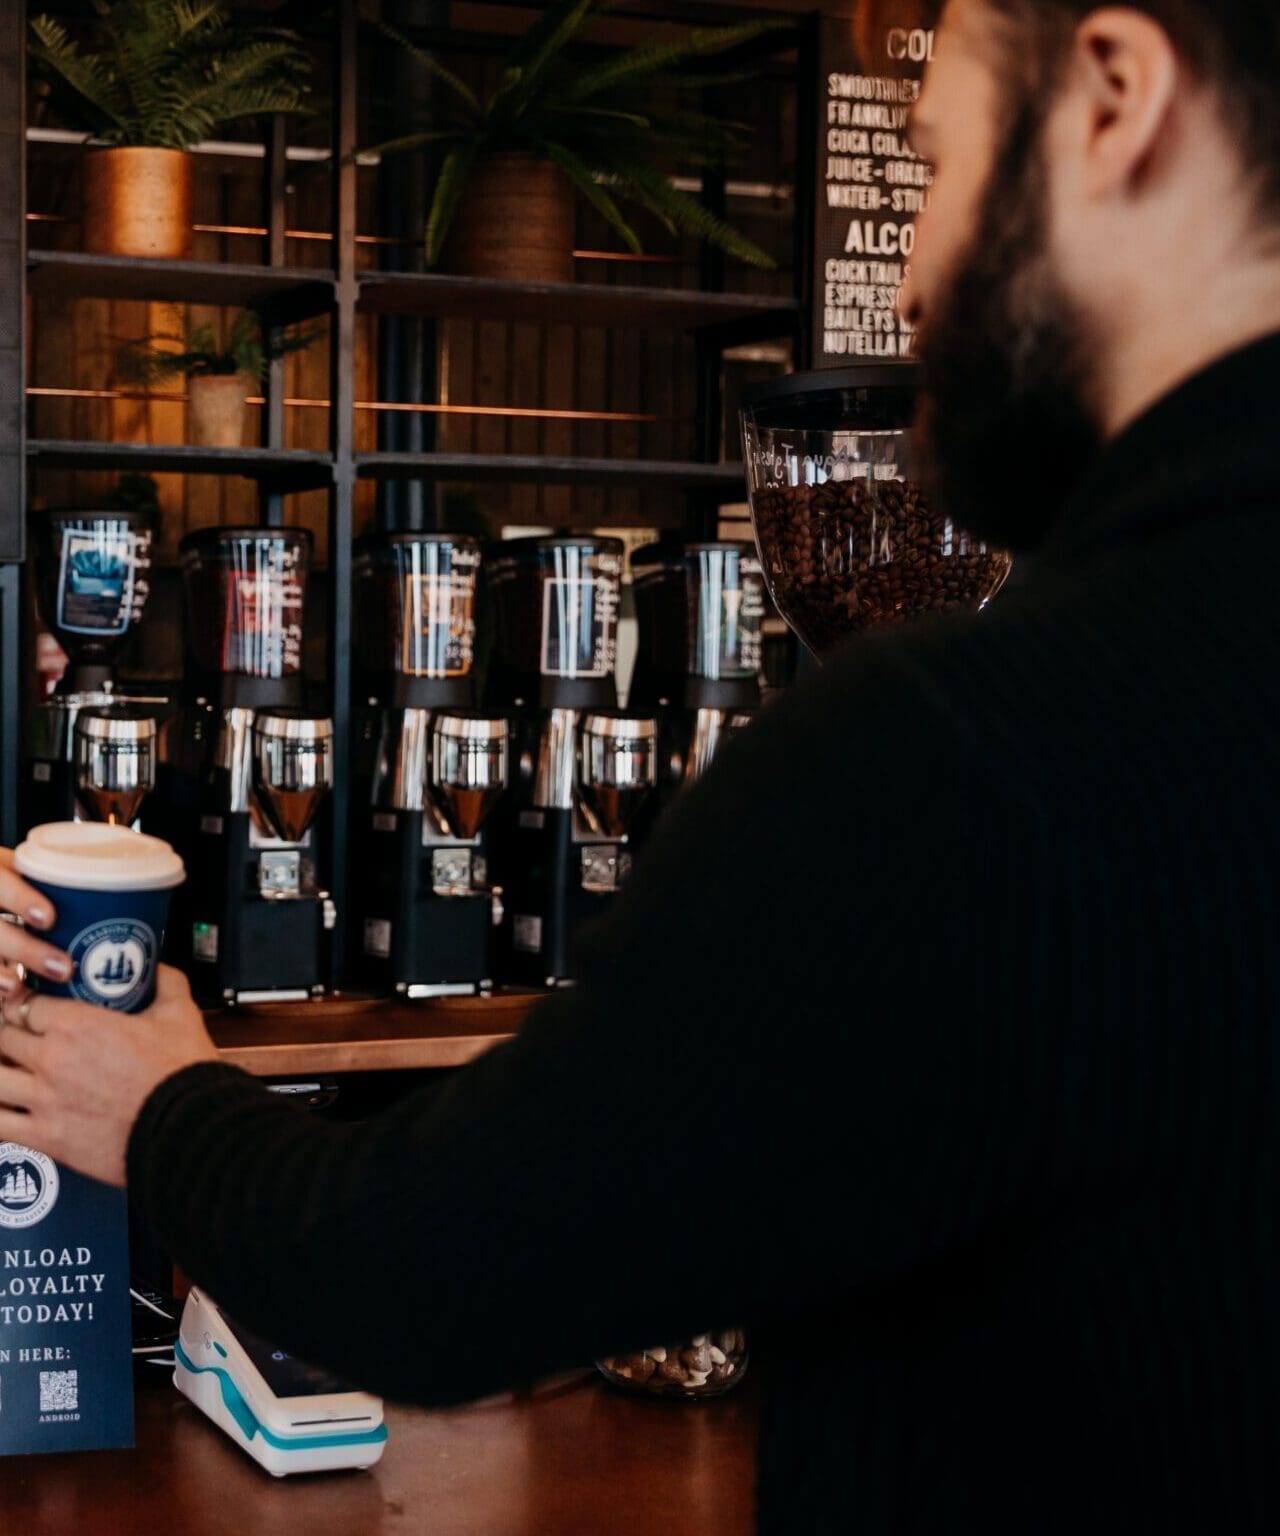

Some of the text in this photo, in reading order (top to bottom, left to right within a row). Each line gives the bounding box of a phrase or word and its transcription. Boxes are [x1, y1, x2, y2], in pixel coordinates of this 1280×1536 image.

[827, 128, 870, 154] COCA
[823, 331, 898, 359] NUTELLA
[0, 1302, 93, 1326] TODAY!
[18, 1346, 71, 1363] HERE:
[38, 1413, 81, 1423] ANDROID
